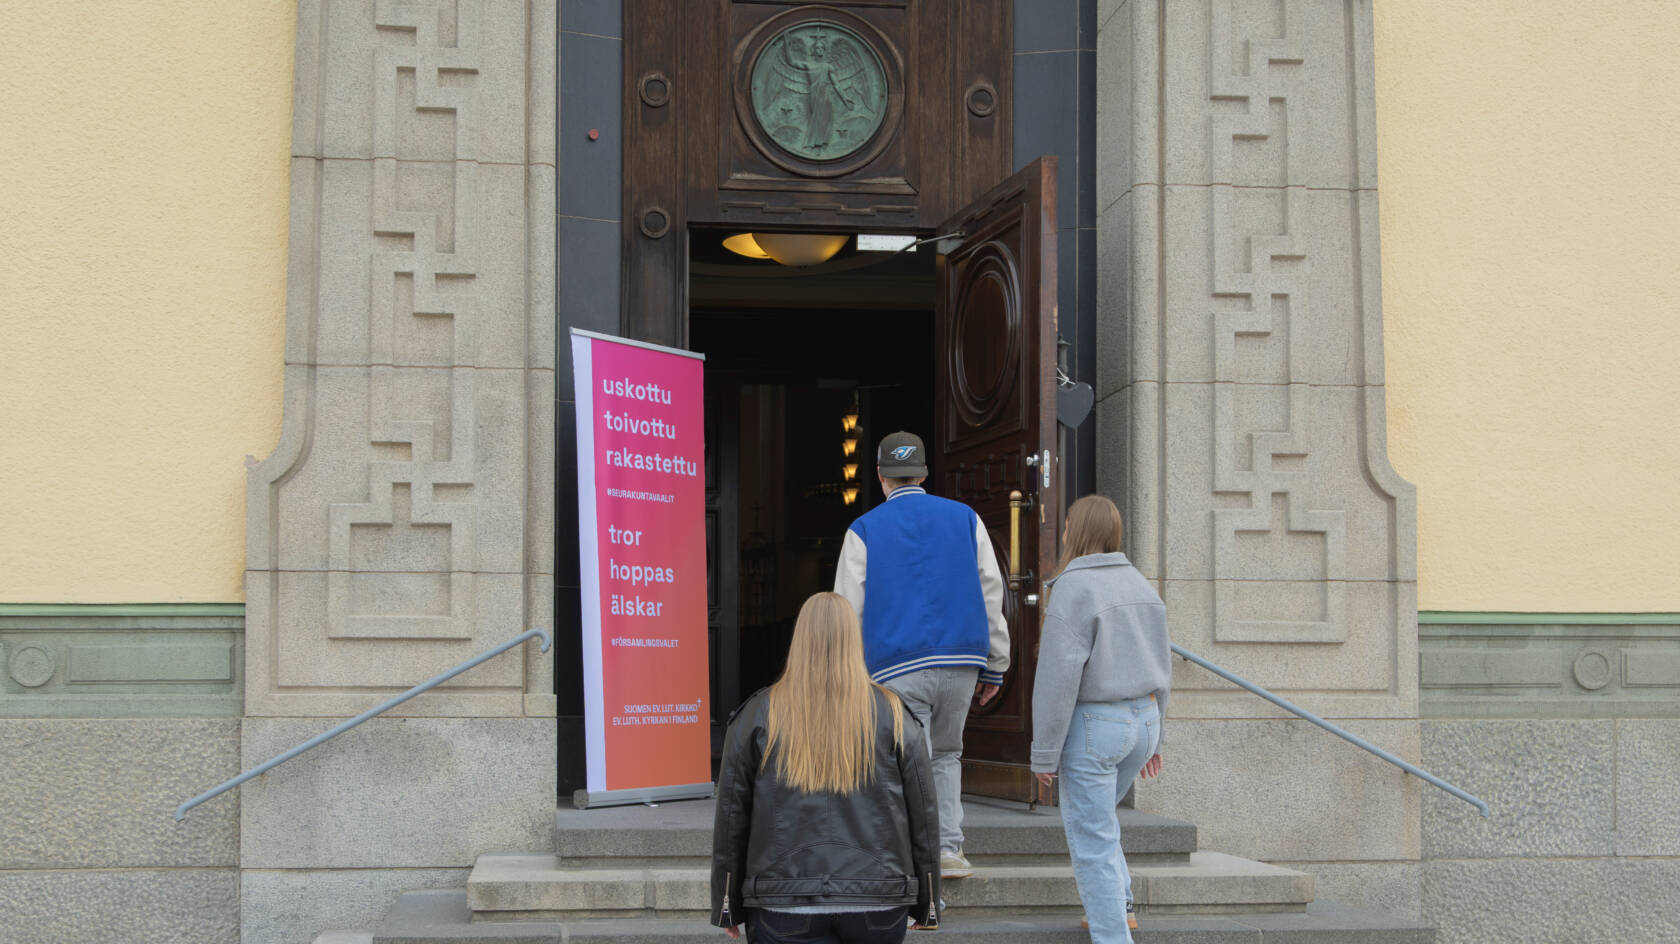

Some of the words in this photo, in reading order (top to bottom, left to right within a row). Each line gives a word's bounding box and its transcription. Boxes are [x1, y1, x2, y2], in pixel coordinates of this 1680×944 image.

[603, 377, 671, 404] uskottu
[604, 410, 676, 439] toivottu
[606, 448, 697, 476] rakastettu
[607, 488, 675, 503] #SEURAKUNTAVAALIT
[608, 524, 642, 546] tror
[610, 558, 674, 586] hoppas
[611, 594, 663, 617] älskar
